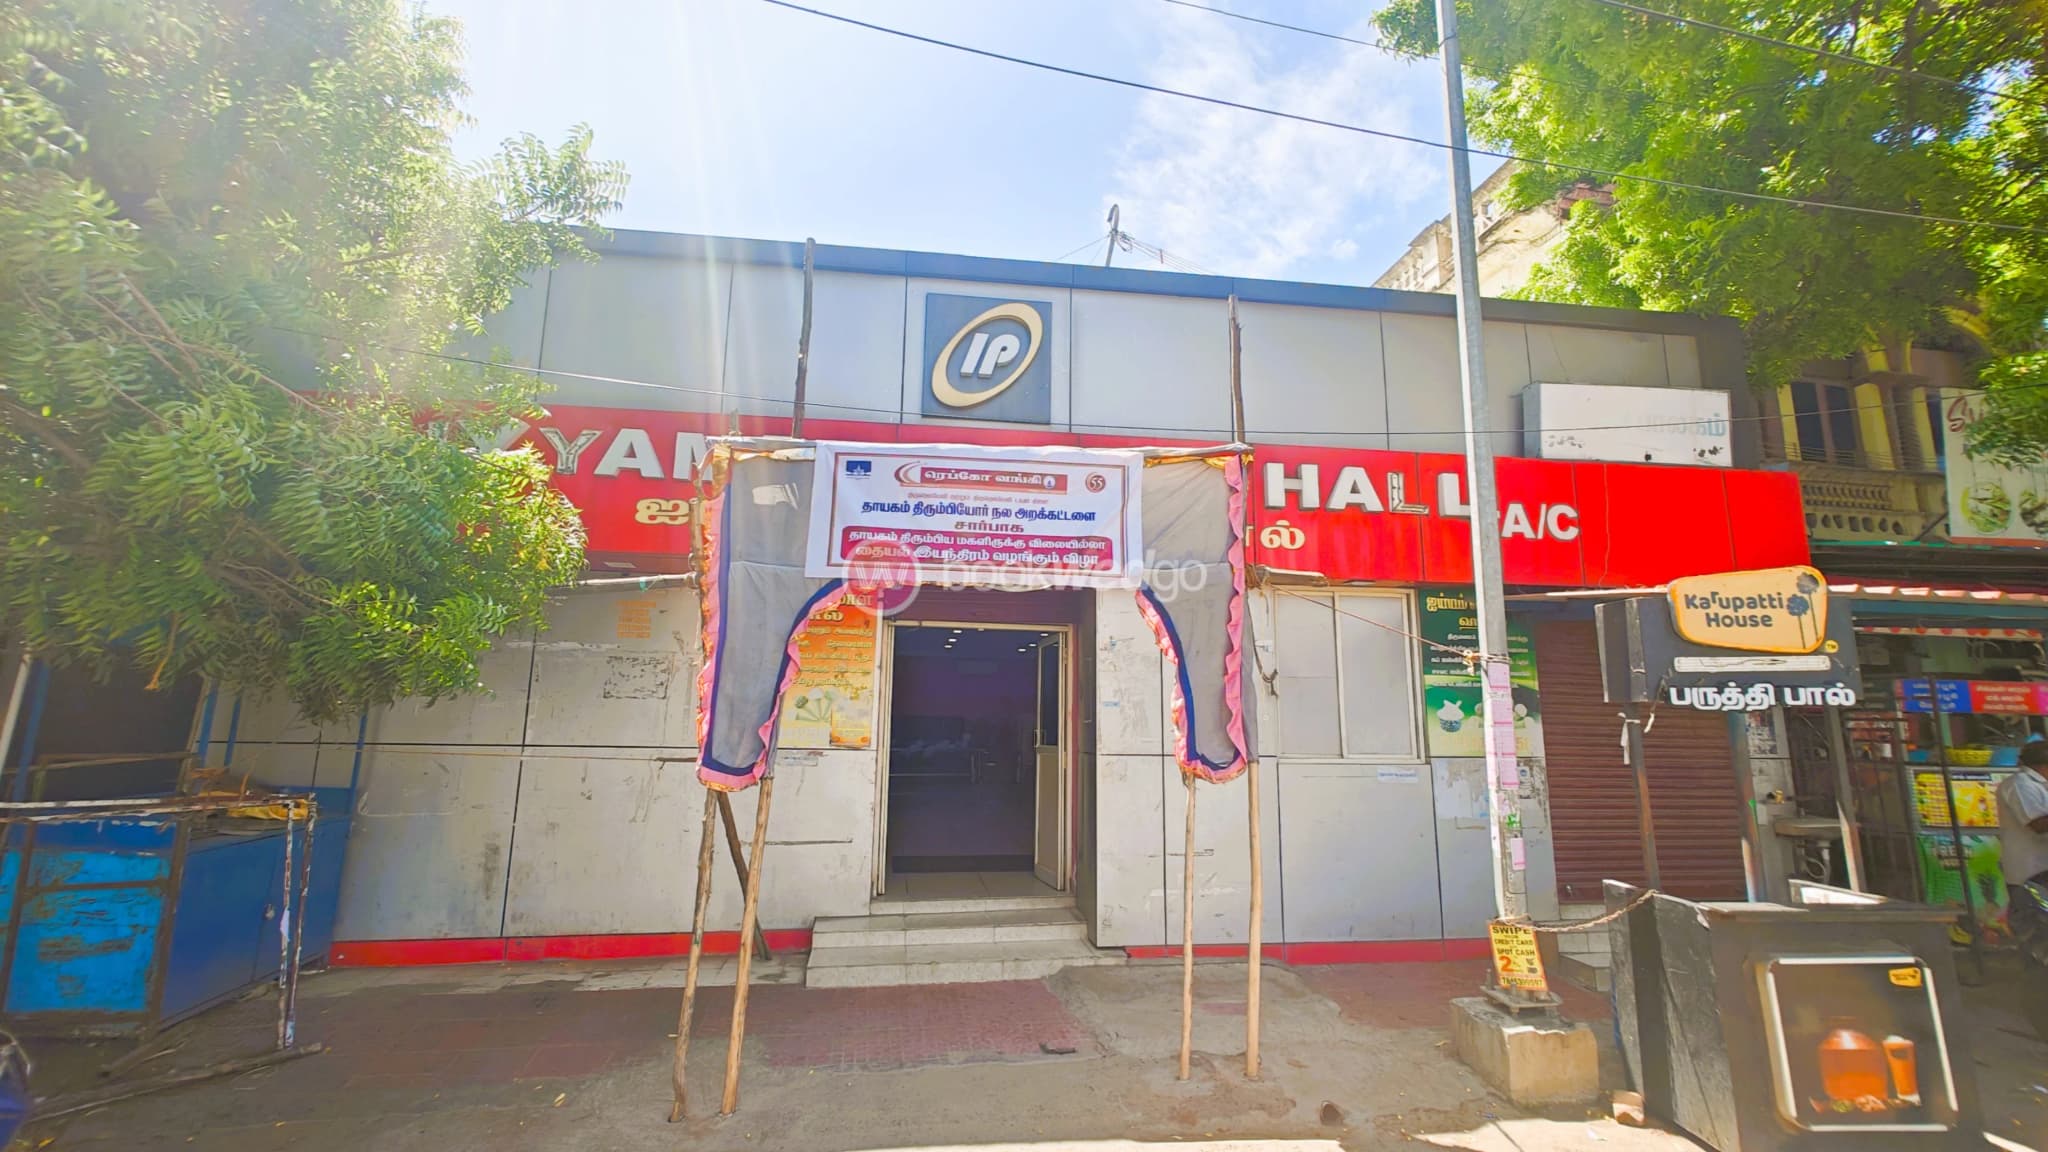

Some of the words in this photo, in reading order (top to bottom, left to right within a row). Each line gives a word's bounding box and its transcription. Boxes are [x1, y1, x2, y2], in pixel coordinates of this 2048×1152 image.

[960, 333, 1020, 378] IP
[1263, 462, 1470, 520] HALL
[861, 500, 911, 513] தாயகம்
[912, 501, 989, 517] திரும்பியோர்
[992, 507, 1012, 520] நல
[1015, 507, 1096, 521] அறக்கட்டளை
[954, 520, 1024, 533] சார்பாக
[849, 531, 898, 542] தாயகம்
[900, 532, 954, 545] திரும்பிய
[956, 535, 1026, 548] மகளிருக்கு
[913, 545, 989, 561] இயந்திரம்
[992, 550, 1060, 565] வழங்கும்
[1063, 552, 1099, 568] விழா
[1684, 591, 1784, 613] Karupatti
[1706, 612, 1773, 628] House
[1669, 681, 1776, 711] பருத்தி
[1784, 682, 1856, 707] பால்
[1492, 926, 1531, 935] SWIPE
